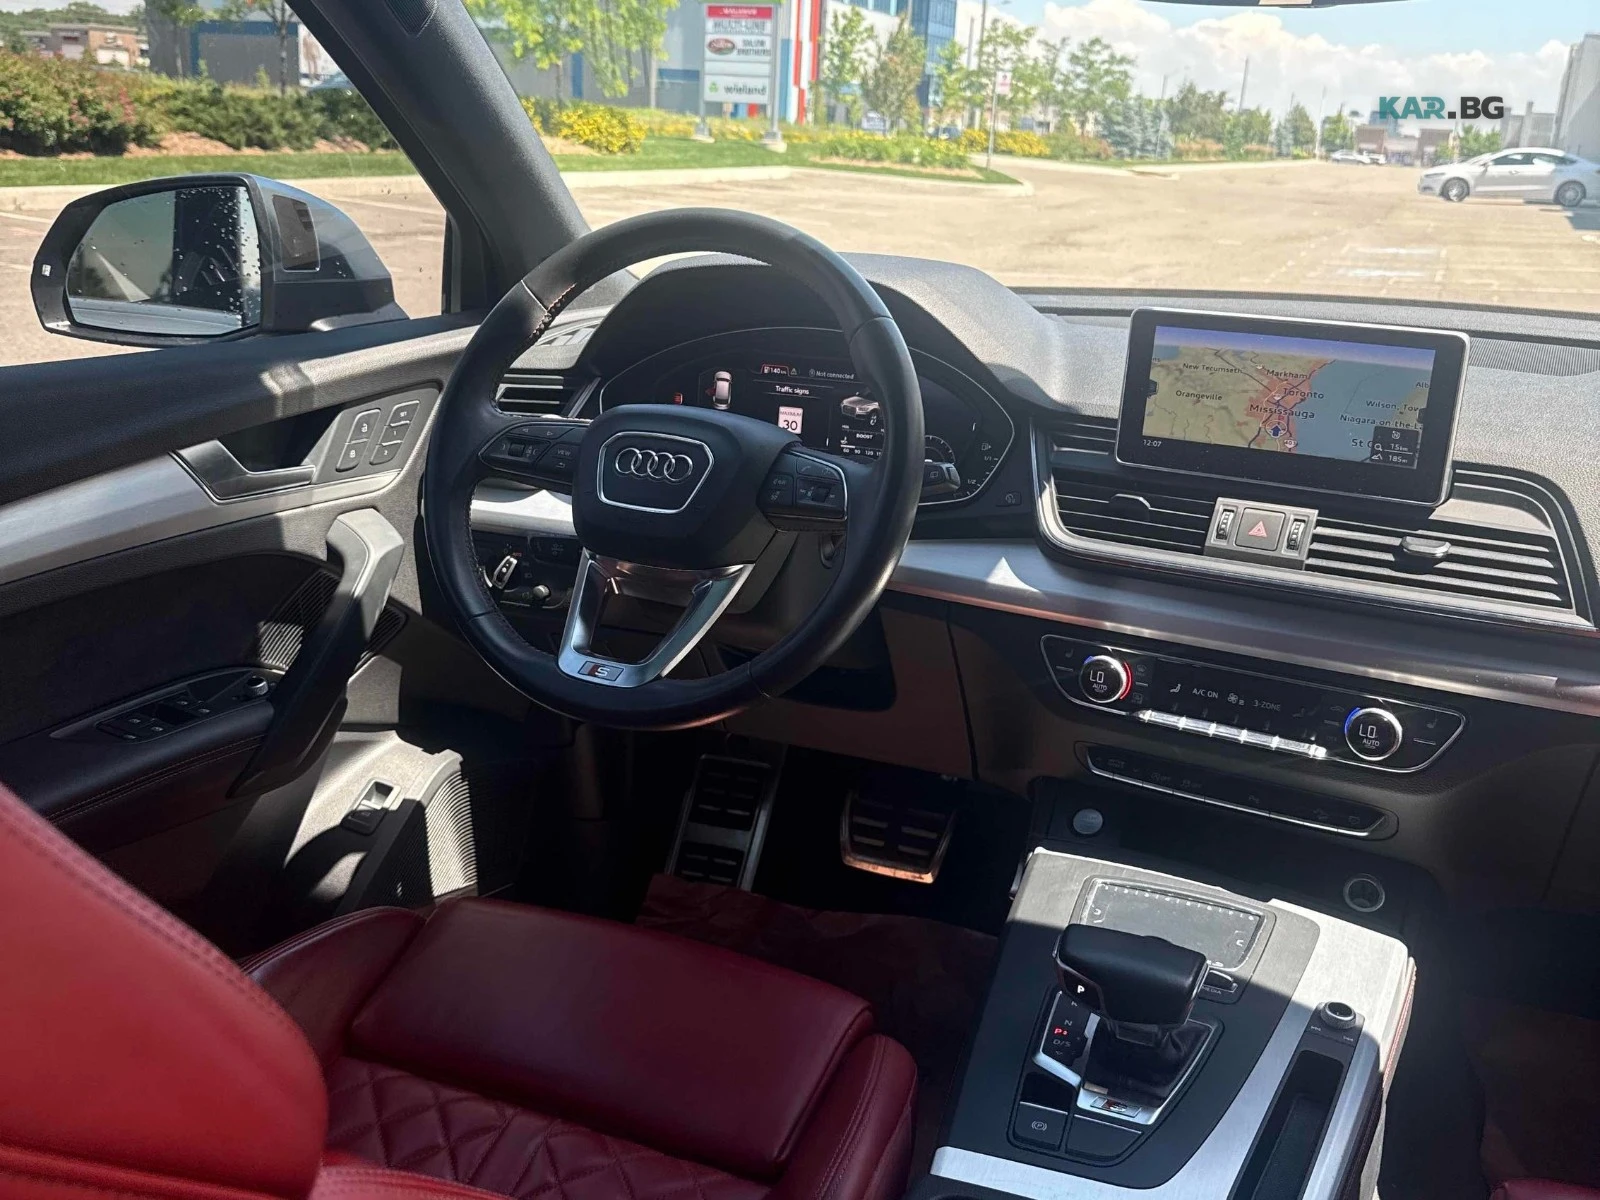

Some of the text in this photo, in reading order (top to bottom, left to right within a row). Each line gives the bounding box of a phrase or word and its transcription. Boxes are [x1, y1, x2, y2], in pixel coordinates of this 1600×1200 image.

[724, 84, 767, 96] wieland
[1202, 364, 1242, 374] Tecumseth
[1266, 369, 1308, 379] Markham
[815, 370, 855, 380] Not connected
[775, 384, 810, 396] Traffic signs
[1283, 387, 1325, 399] Toronto
[1175, 390, 1223, 401] Orangeville
[1249, 404, 1316, 420] Mississauga
[783, 419, 798, 431] 30
[1143, 439, 1162, 448] 12:07
[1351, 438, 1364, 448] St
[1089, 670, 1104, 684] LO
[1092, 683, 1108, 691] AUTO
[1192, 687, 1219, 699] A/C ON
[1252, 699, 1281, 712] 3-ZONE
[1358, 723, 1377, 739] LO
[1362, 738, 1380, 747] AUTO
[1076, 984, 1086, 994] P
[1064, 1019, 1073, 1027] N
[1053, 1038, 1072, 1048] D/S
